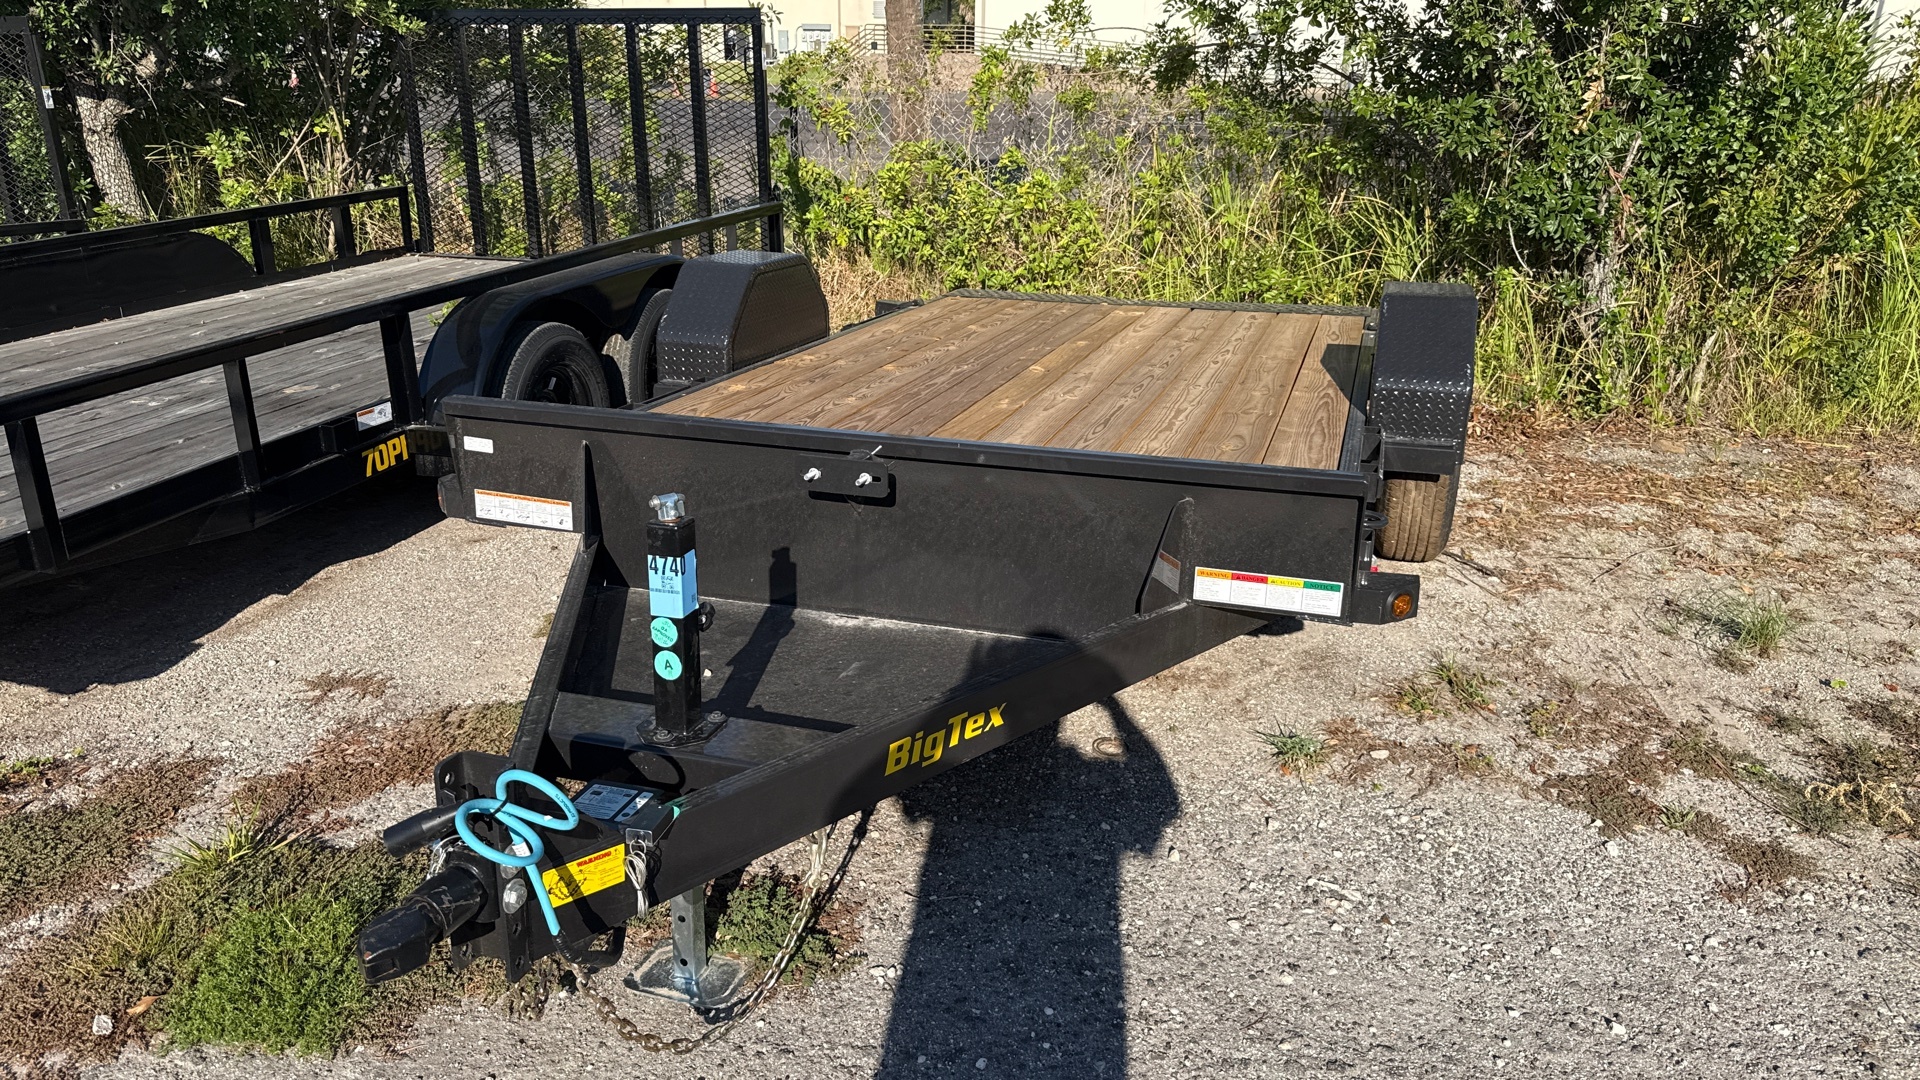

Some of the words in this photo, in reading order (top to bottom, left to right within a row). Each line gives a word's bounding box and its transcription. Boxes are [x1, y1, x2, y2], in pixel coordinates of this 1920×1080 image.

[649, 555, 686, 576] 4740
[1199, 571, 1229, 579] WARNING
[1241, 575, 1264, 583] DANGER
[1275, 579, 1301, 587] CAUTION
[664, 659, 673, 670] A
